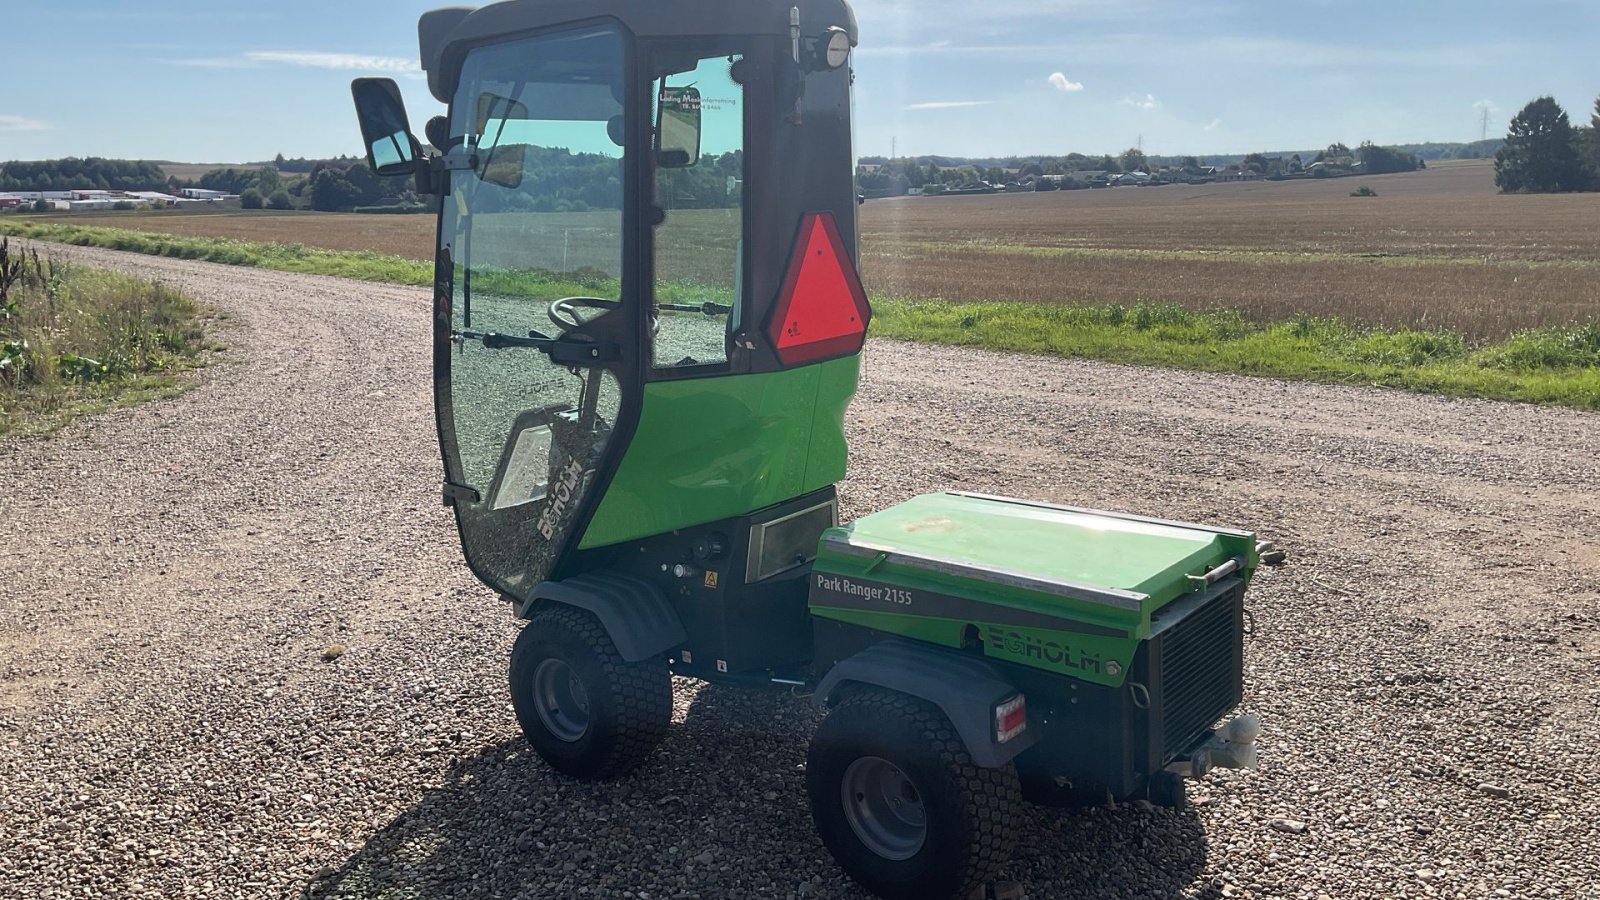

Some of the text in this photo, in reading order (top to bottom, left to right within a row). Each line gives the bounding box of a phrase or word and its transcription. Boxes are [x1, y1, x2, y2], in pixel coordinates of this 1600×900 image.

[817, 574, 912, 605] Park Ranger 2155
[988, 627, 1100, 674] EGHOLM
